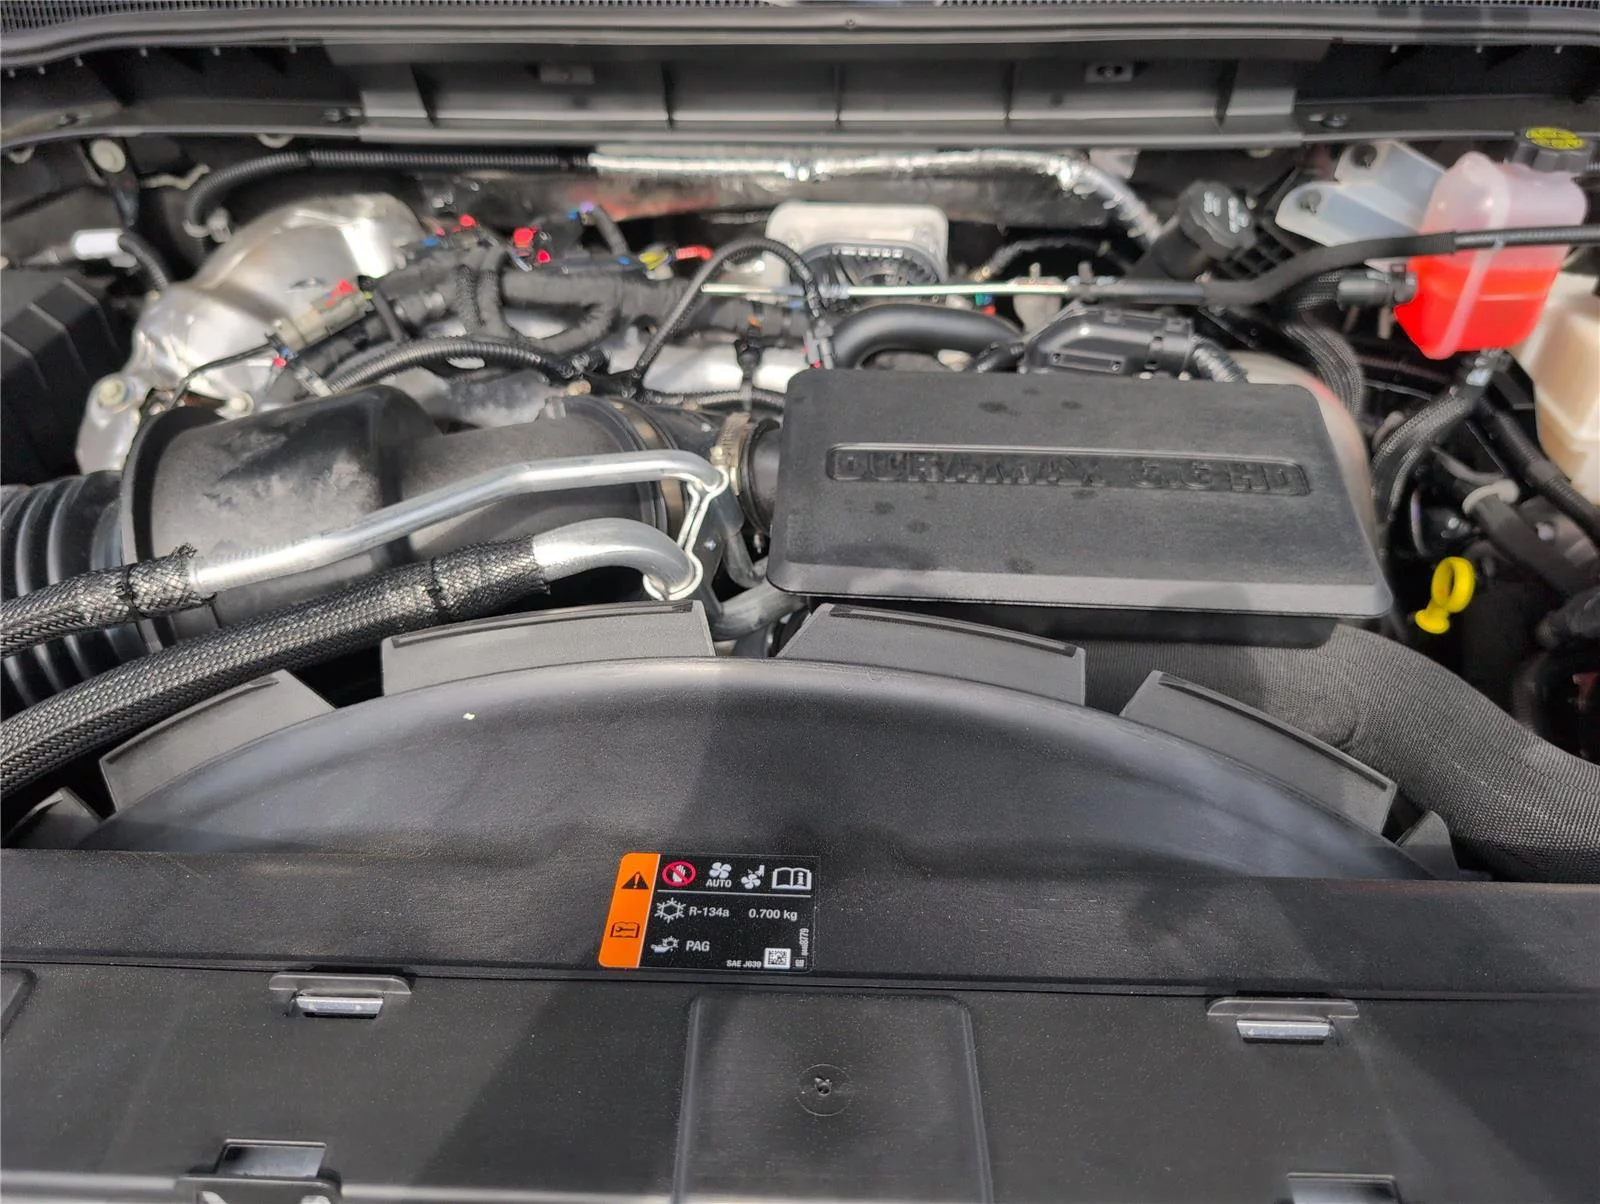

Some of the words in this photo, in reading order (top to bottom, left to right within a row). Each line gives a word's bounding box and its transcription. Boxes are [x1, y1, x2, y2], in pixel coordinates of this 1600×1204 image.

[705, 878, 732, 888] AUTO
[688, 906, 730, 918] R-134a
[748, 908, 781, 919] 0.700
[783, 909, 798, 922] kg
[685, 940, 711, 952] PAG
[726, 959, 742, 968] SAE
[742, 960, 762, 969] J639
